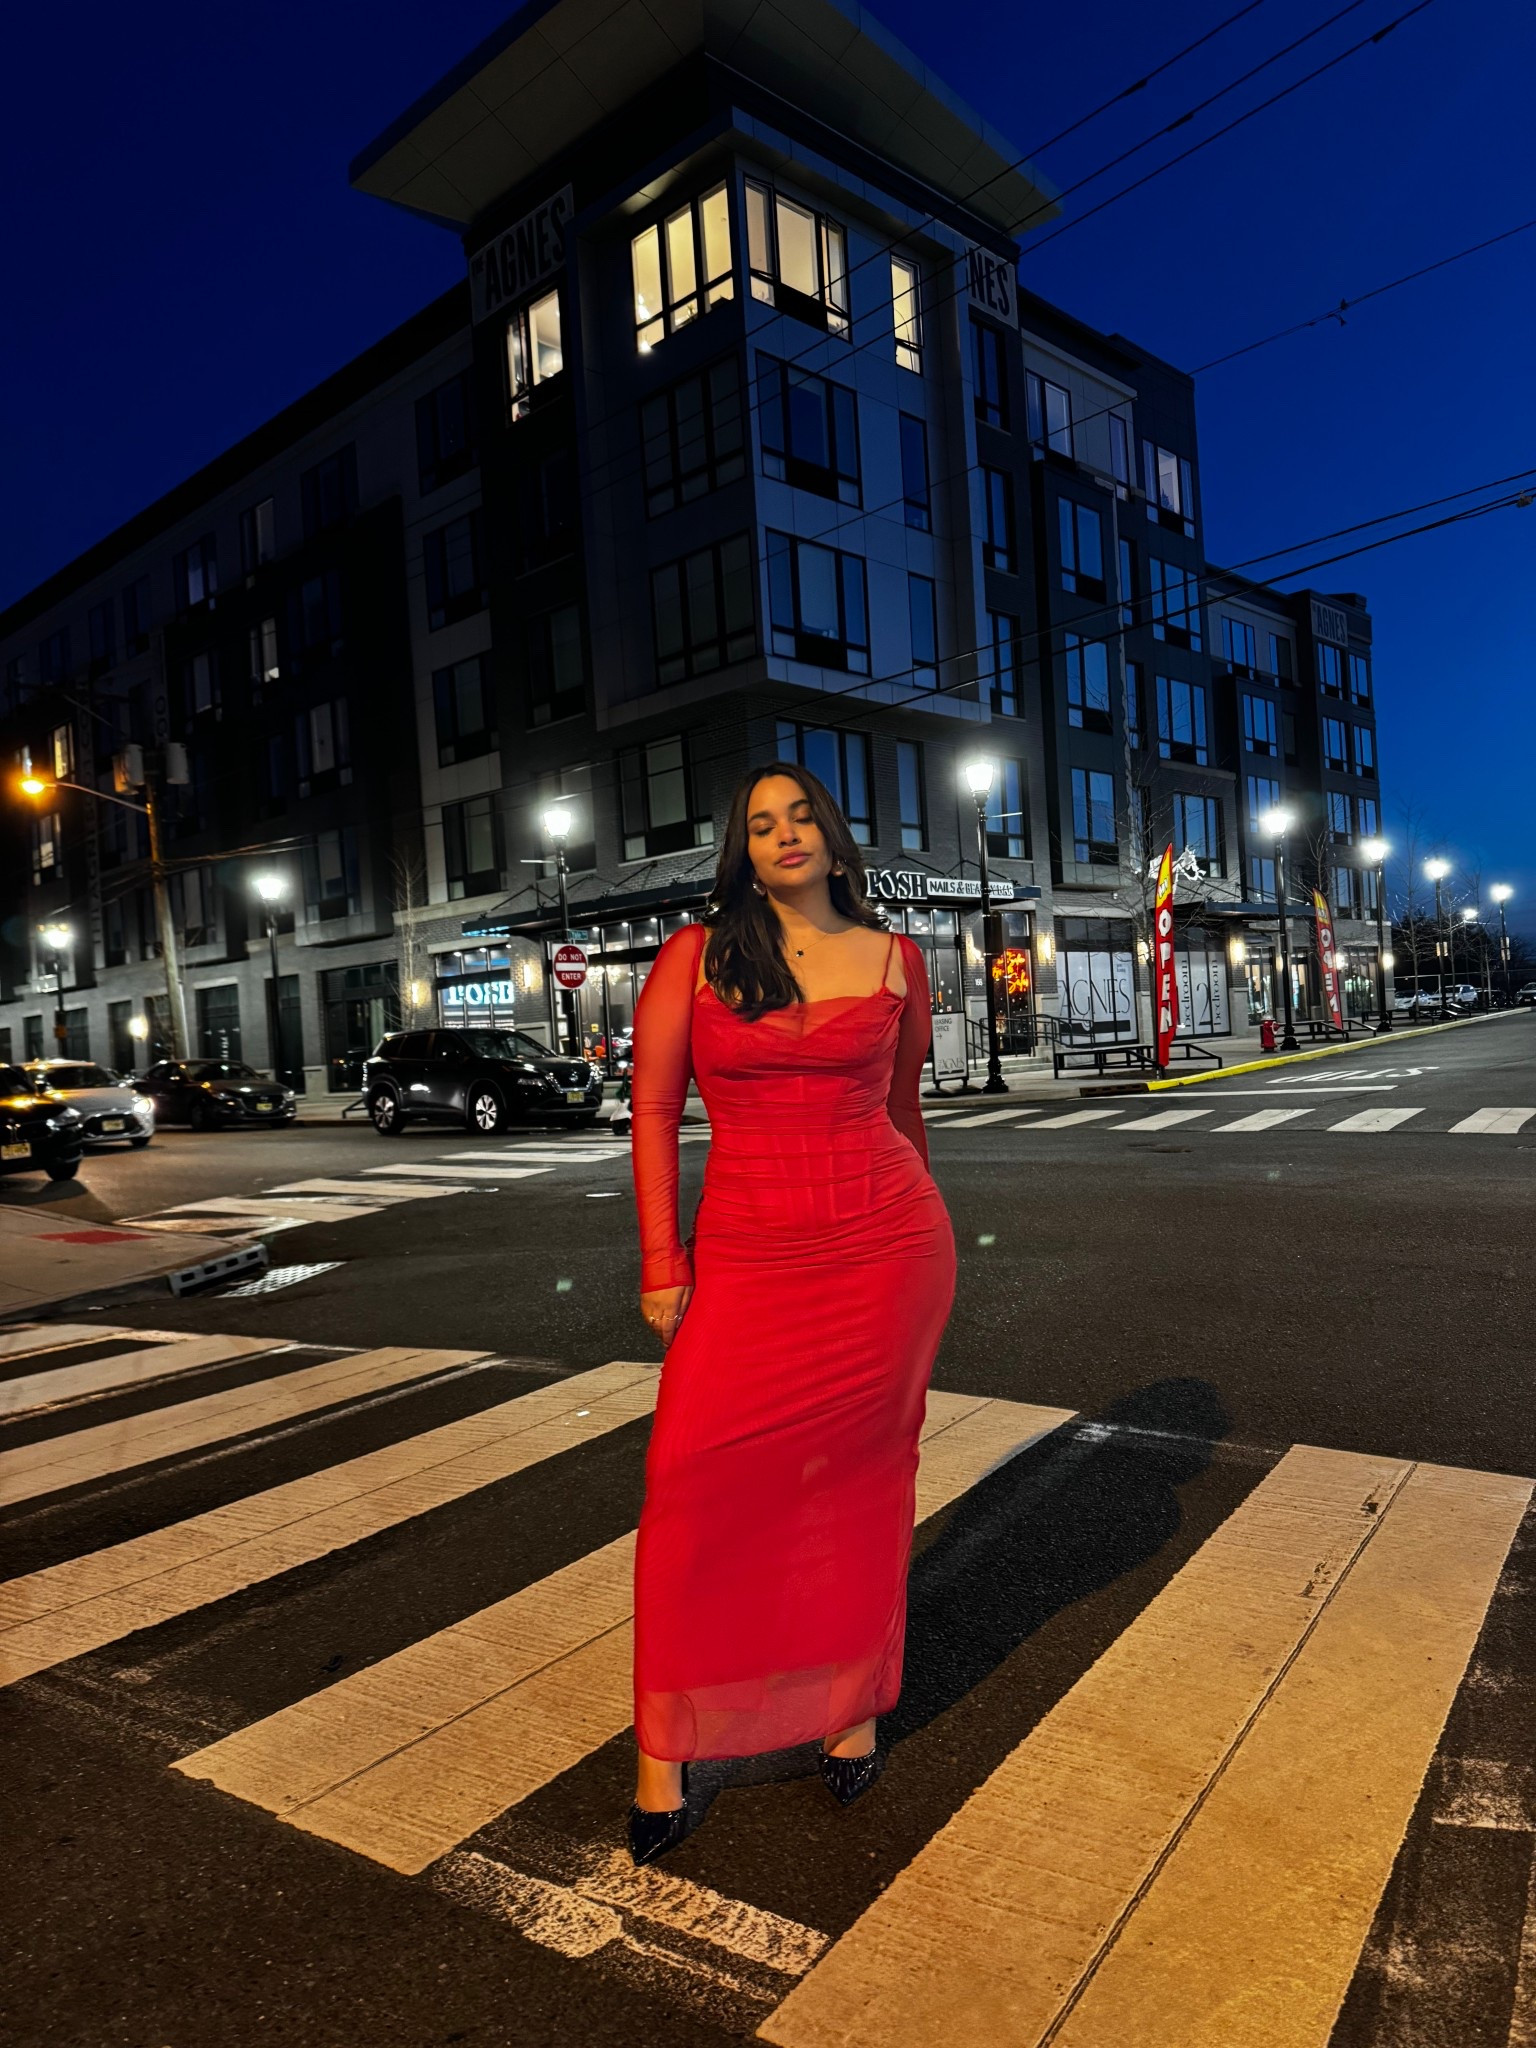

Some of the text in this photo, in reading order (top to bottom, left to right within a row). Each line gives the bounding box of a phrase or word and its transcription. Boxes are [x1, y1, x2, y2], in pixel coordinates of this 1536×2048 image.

[486, 196, 565, 310] AGNES
[965, 242, 1010, 316] NES
[1317, 606, 1346, 643] AGNES
[864, 869, 928, 900] POSH
[929, 881, 955, 895] NAILS
[956, 882, 965, 895] &
[965, 883, 996, 897] BEAY
[558, 953, 583, 961] DO NOT
[561, 972, 583, 981] ENTER
[1158, 909, 1173, 1034] OPEN
[1059, 978, 1131, 1017] AGNES
[1180, 959, 1192, 1028] bedroom
[1196, 982, 1211, 1026] 2
[1211, 959, 1222, 1026] bedroom
[934, 1017, 953, 1025] LEASING
[935, 1025, 950, 1033] OFFICE
